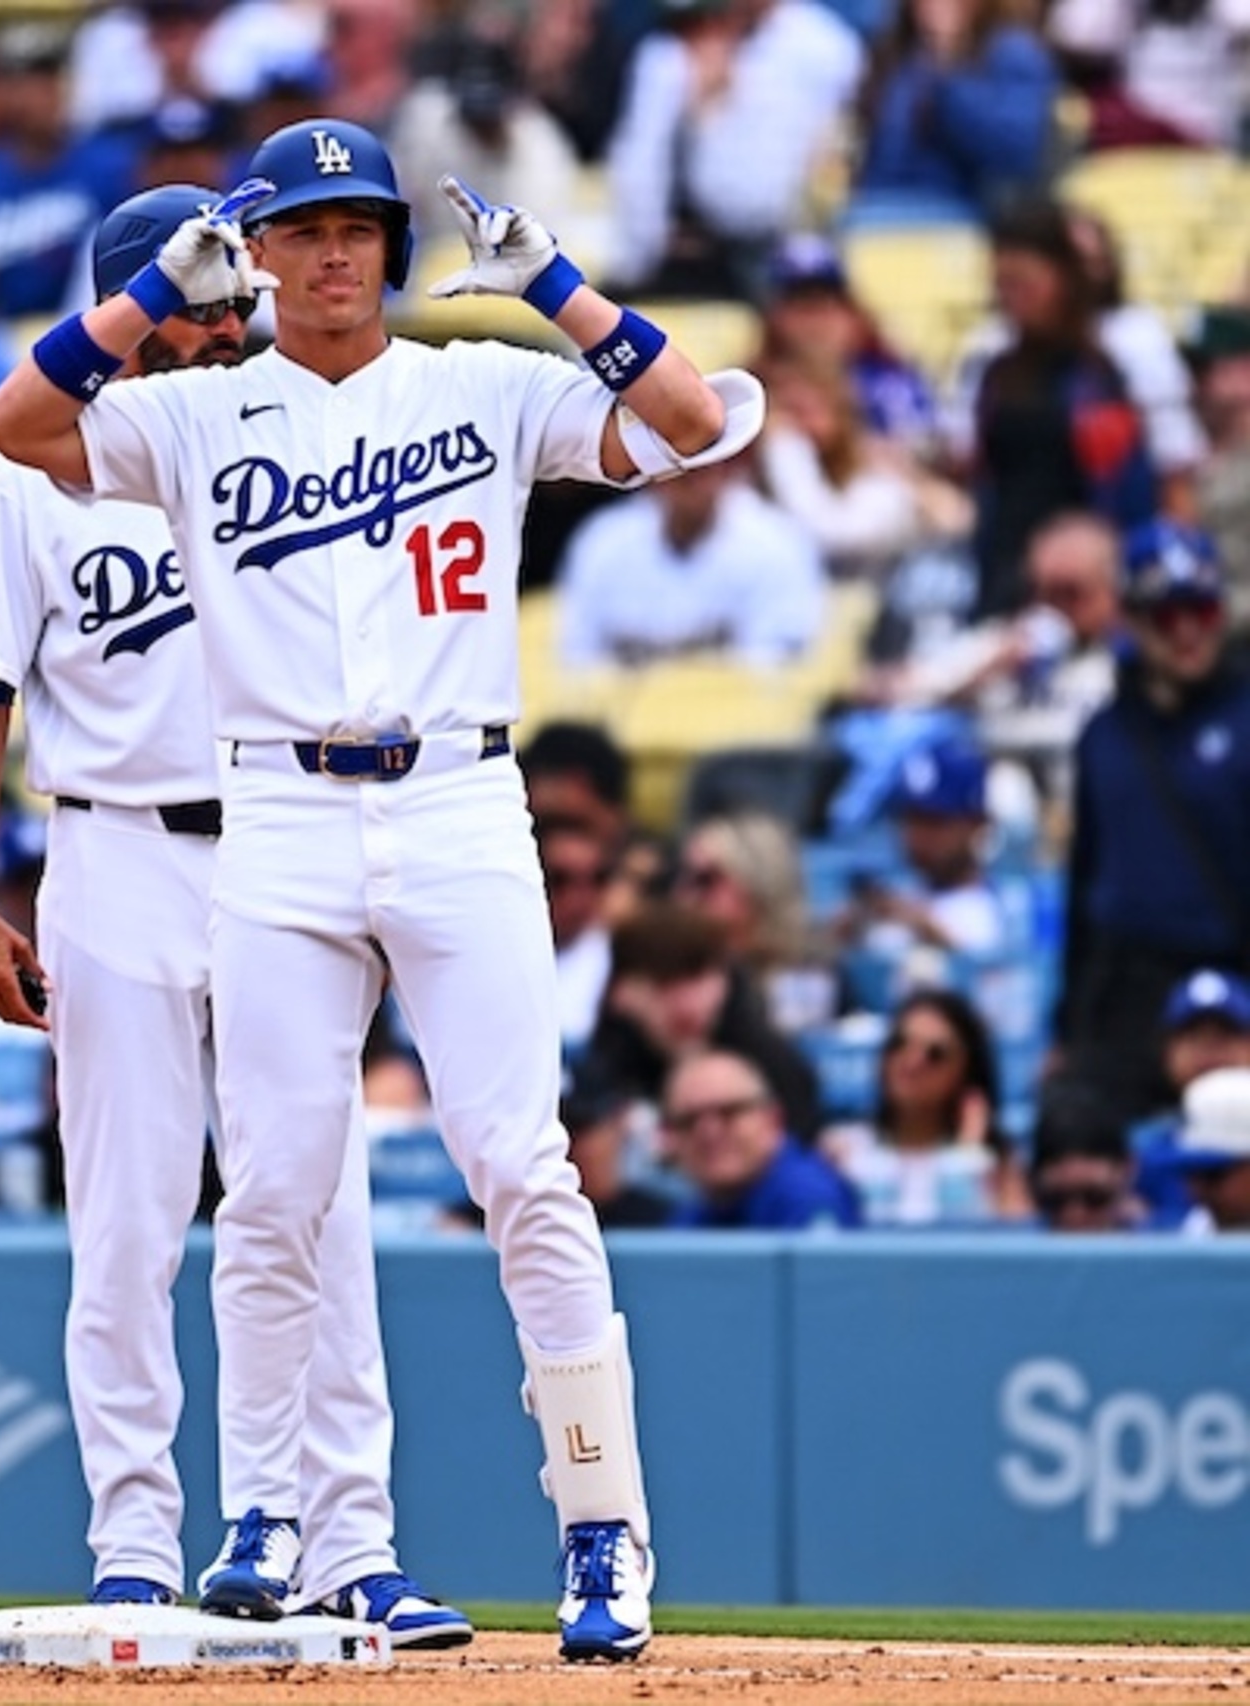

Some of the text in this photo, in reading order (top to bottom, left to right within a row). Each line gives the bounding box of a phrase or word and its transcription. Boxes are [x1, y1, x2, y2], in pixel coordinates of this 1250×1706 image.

[312, 131, 351, 174] LA
[211, 421, 498, 550] Dodgers
[405, 520, 488, 616] 12
